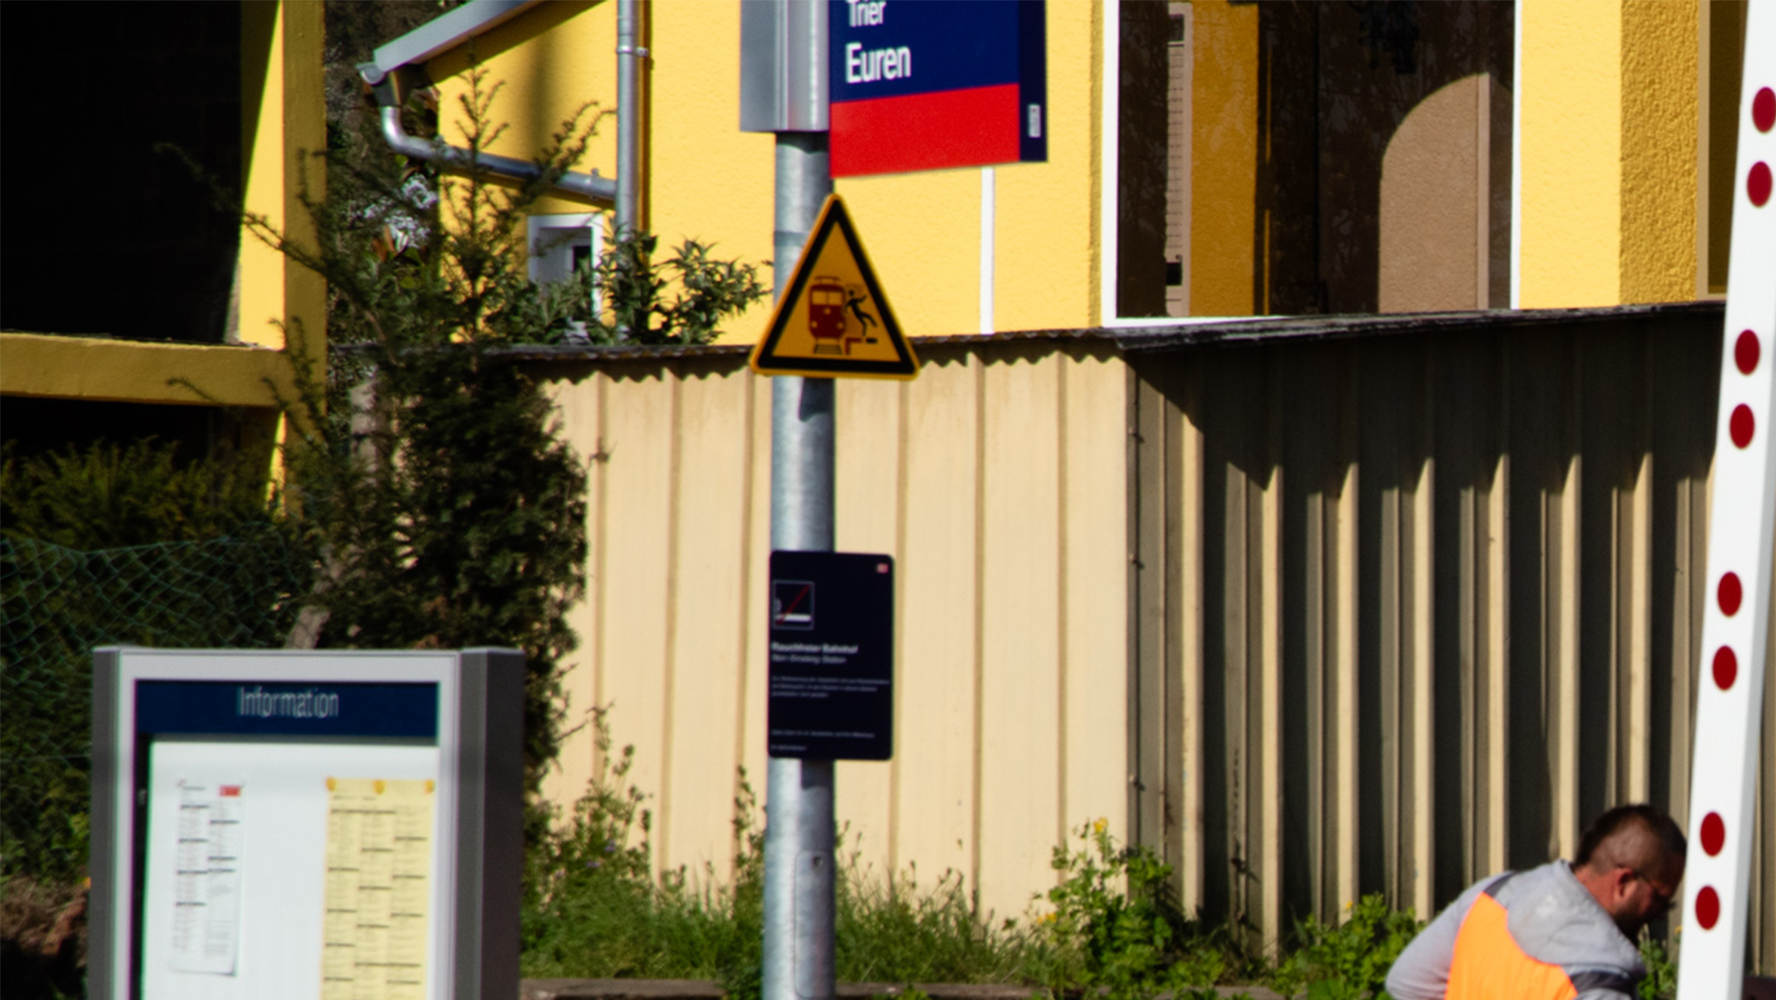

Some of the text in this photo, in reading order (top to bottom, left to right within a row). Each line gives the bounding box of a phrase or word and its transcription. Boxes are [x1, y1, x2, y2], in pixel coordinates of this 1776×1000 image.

[846, 0, 887, 27] Trier
[845, 42, 912, 84] Euren
[238, 686, 340, 719] Information
